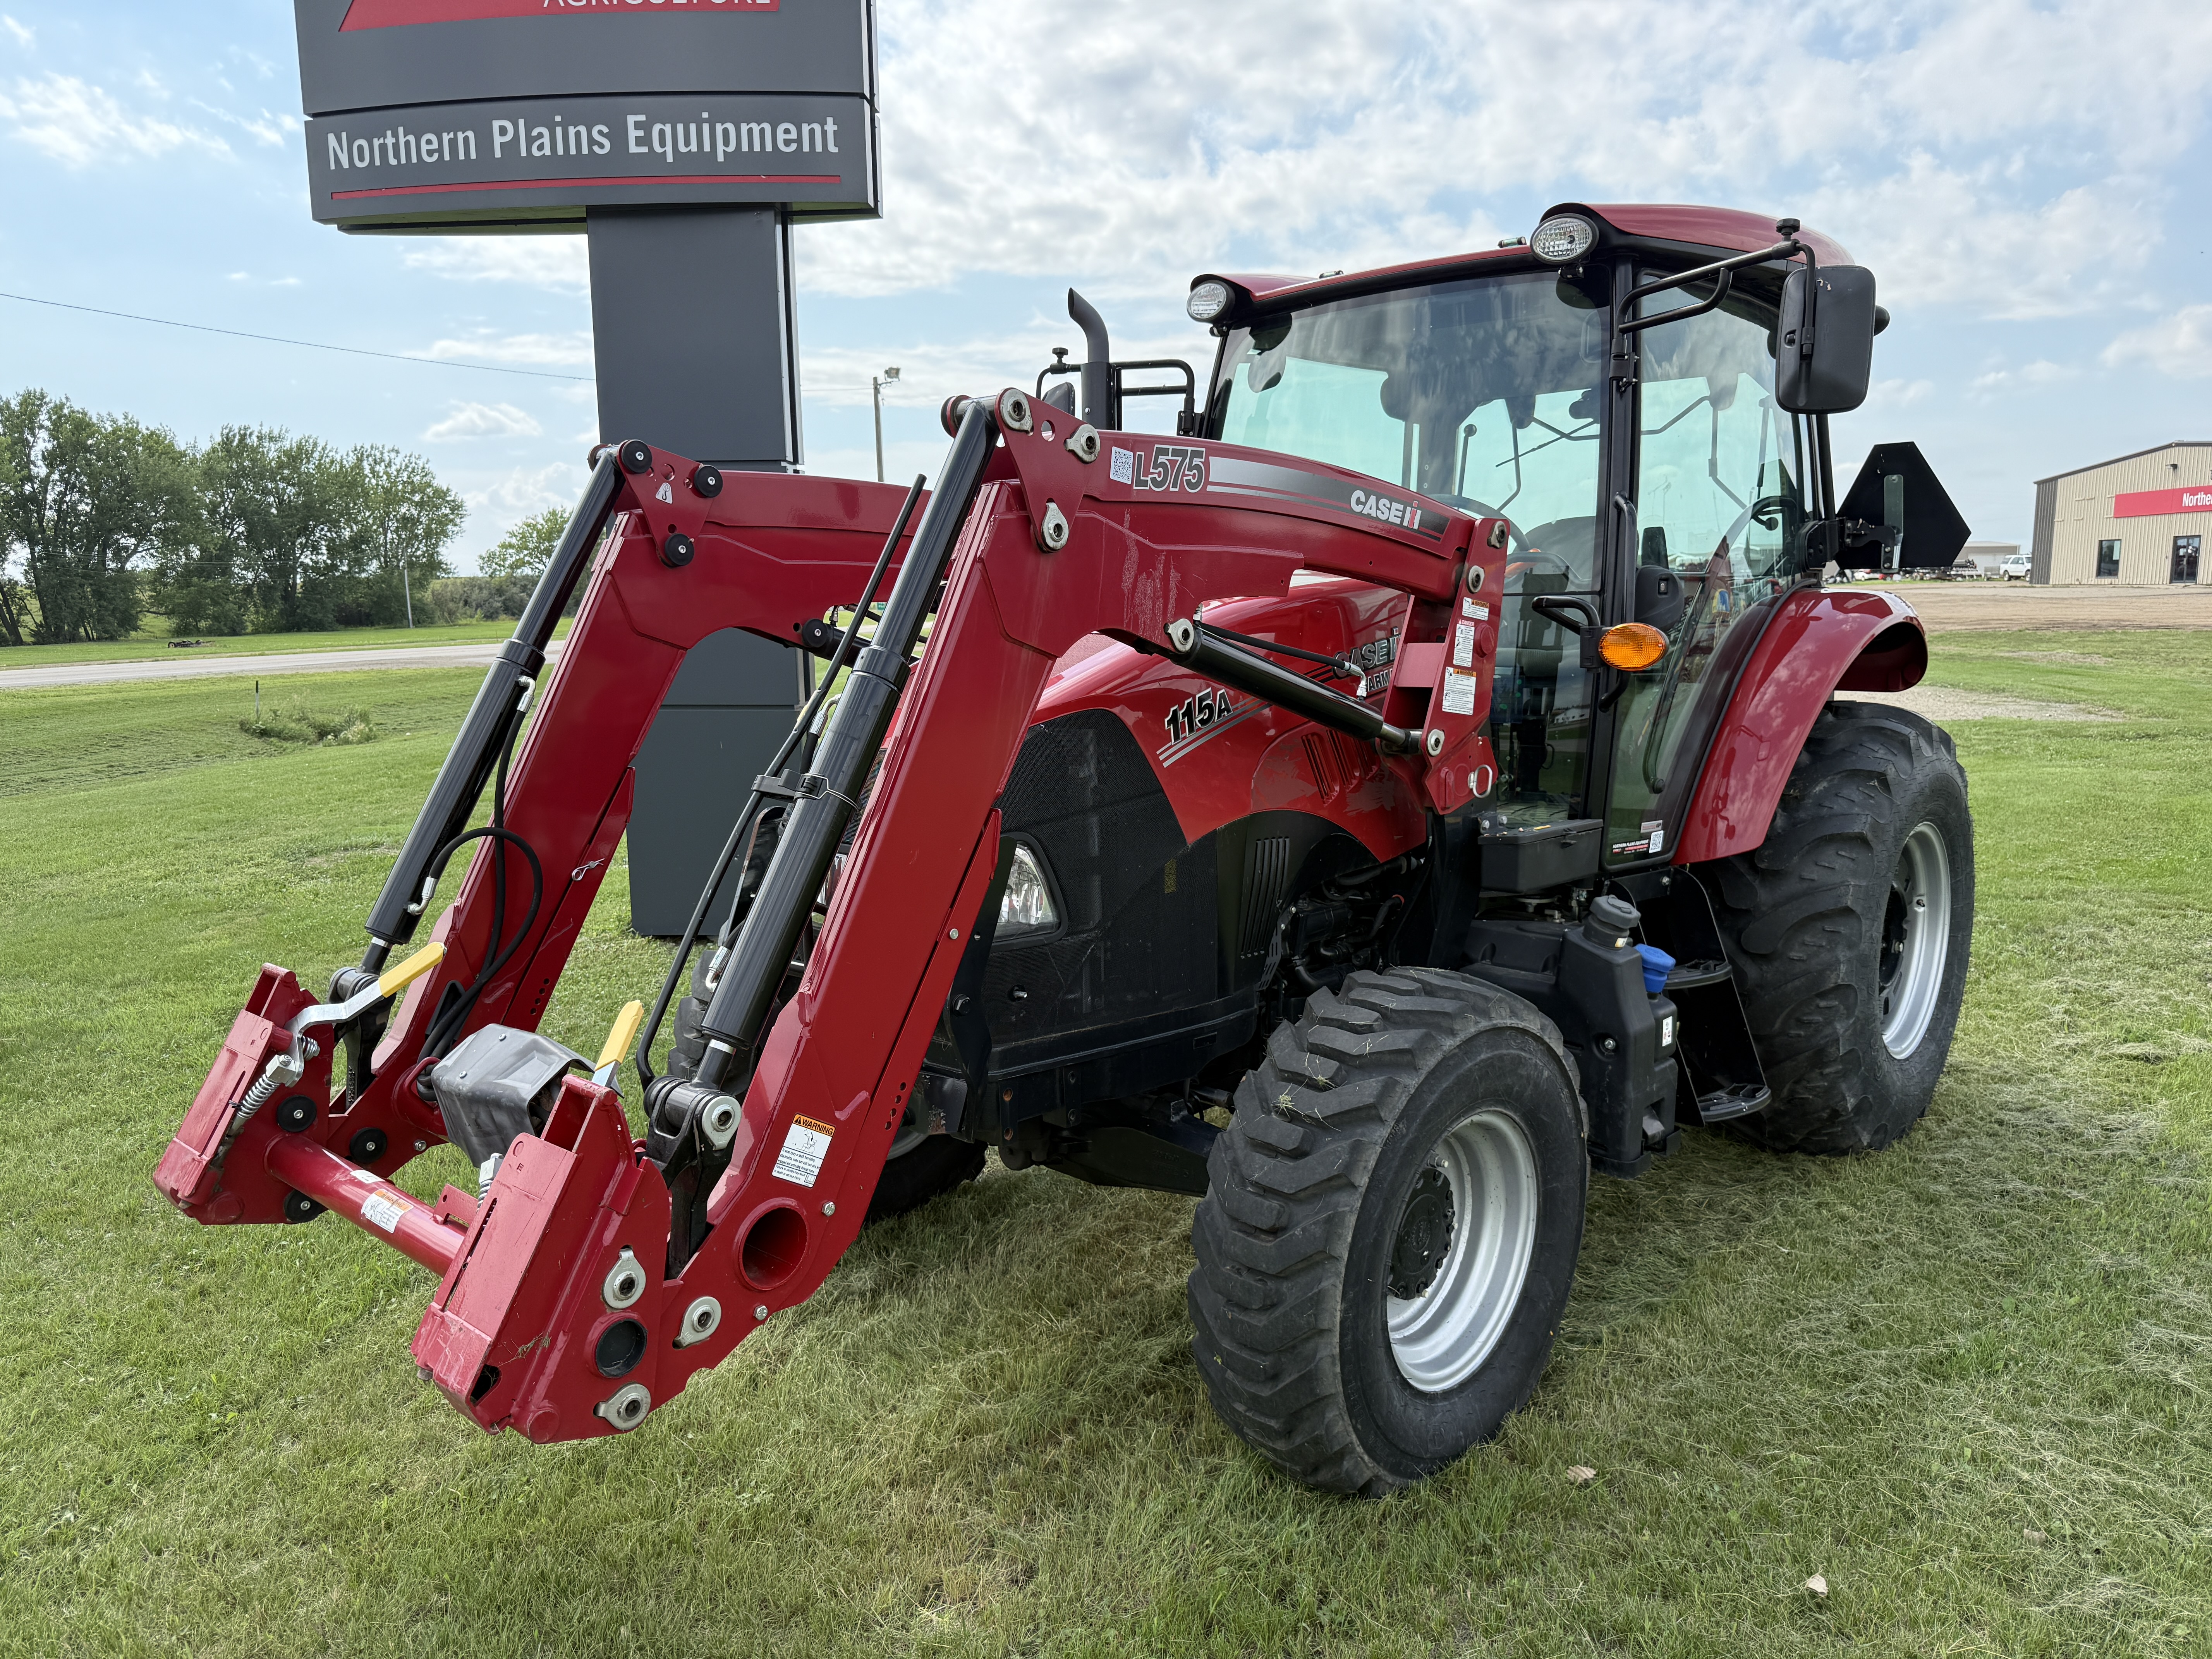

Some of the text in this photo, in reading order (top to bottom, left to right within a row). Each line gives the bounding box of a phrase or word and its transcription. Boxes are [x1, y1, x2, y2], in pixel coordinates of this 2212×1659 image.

[328, 112, 838, 170] Northern Plains Equipment
[1133, 445, 1205, 493] L575
[1351, 490, 1403, 524] CASE
[1335, 639, 1388, 678] CASE
[1368, 668, 1392, 692] ARM
[1165, 687, 1233, 745] 115A
[802, 1118, 833, 1135] WARNING
